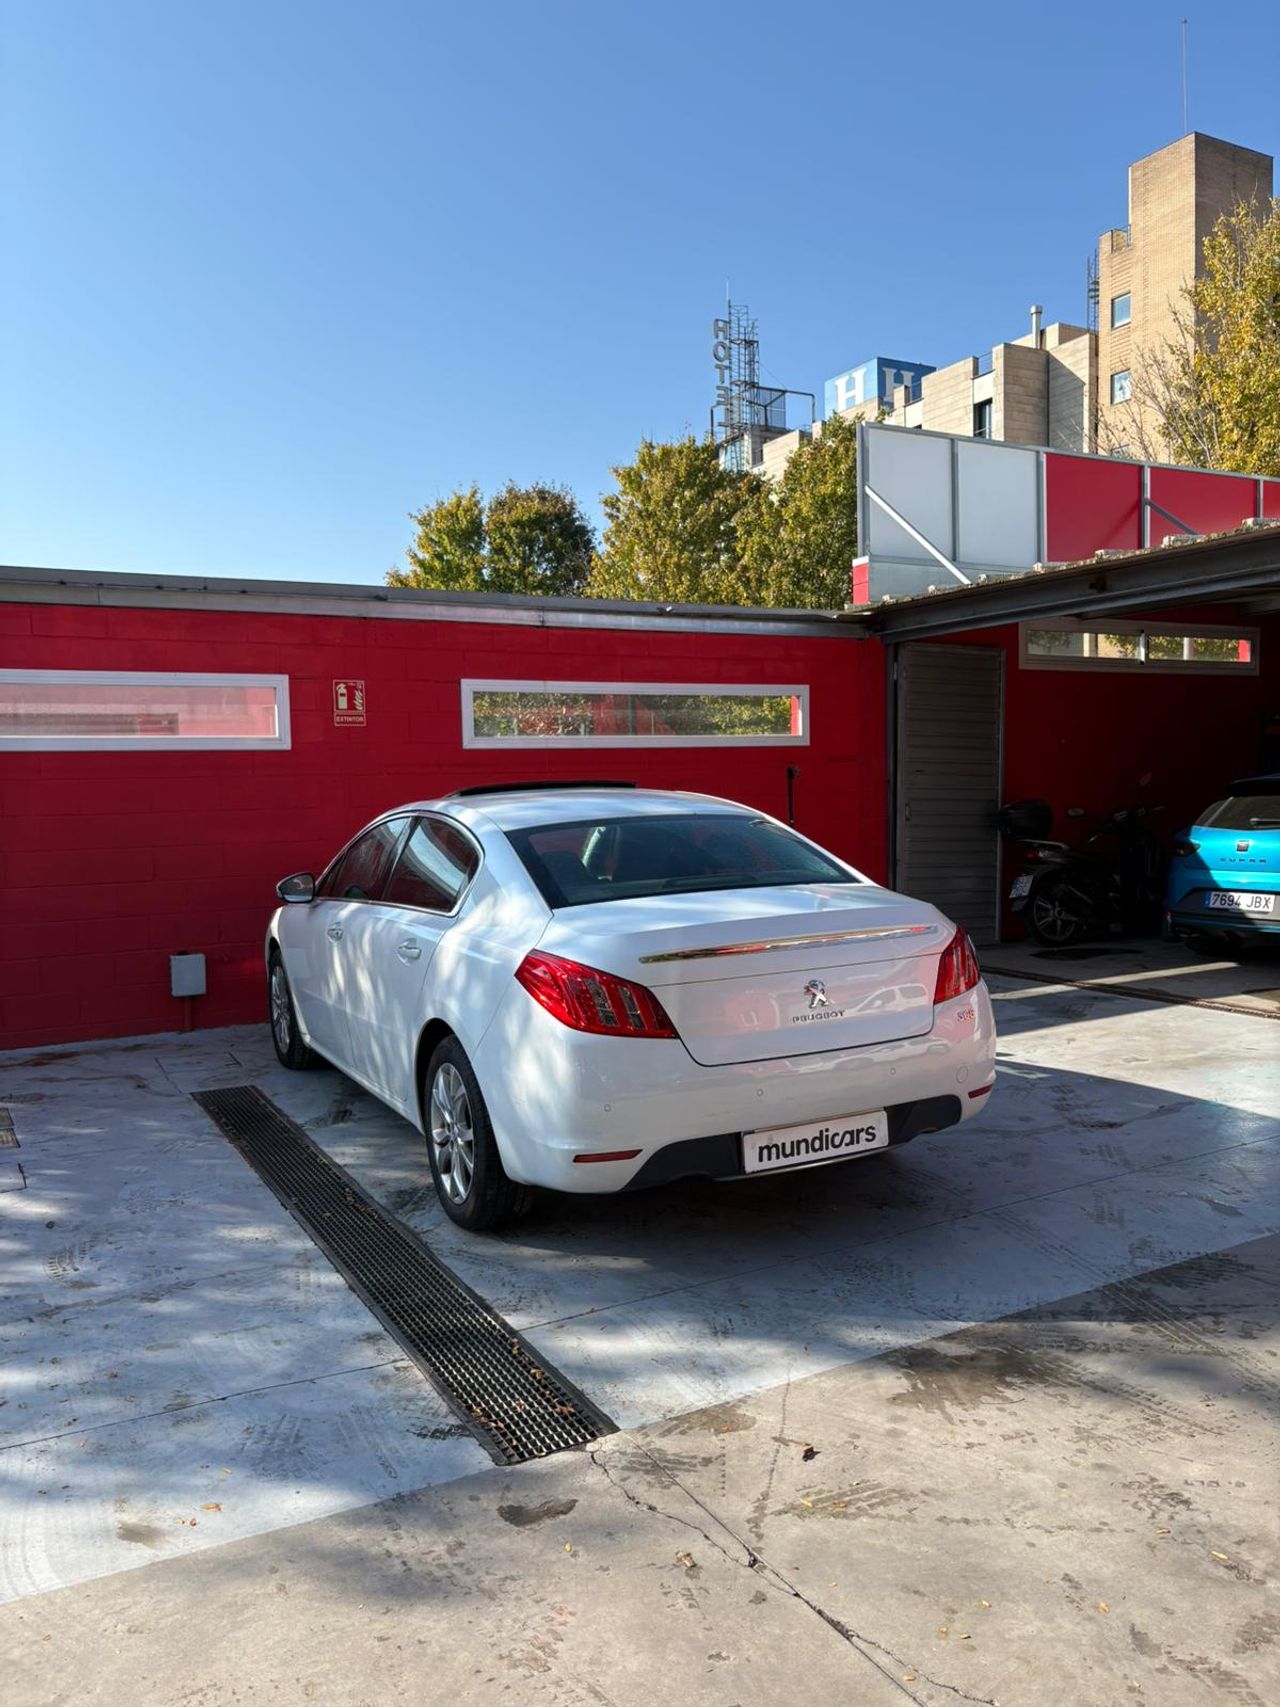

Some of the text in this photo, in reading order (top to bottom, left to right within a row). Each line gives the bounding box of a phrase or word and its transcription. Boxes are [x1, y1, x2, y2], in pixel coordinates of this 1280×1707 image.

[835, 367, 867, 413] H
[1211, 893, 1271, 909] 7694 JBX
[792, 1009, 845, 1023] PEUGEOT
[758, 1125, 877, 1163] mundicars
